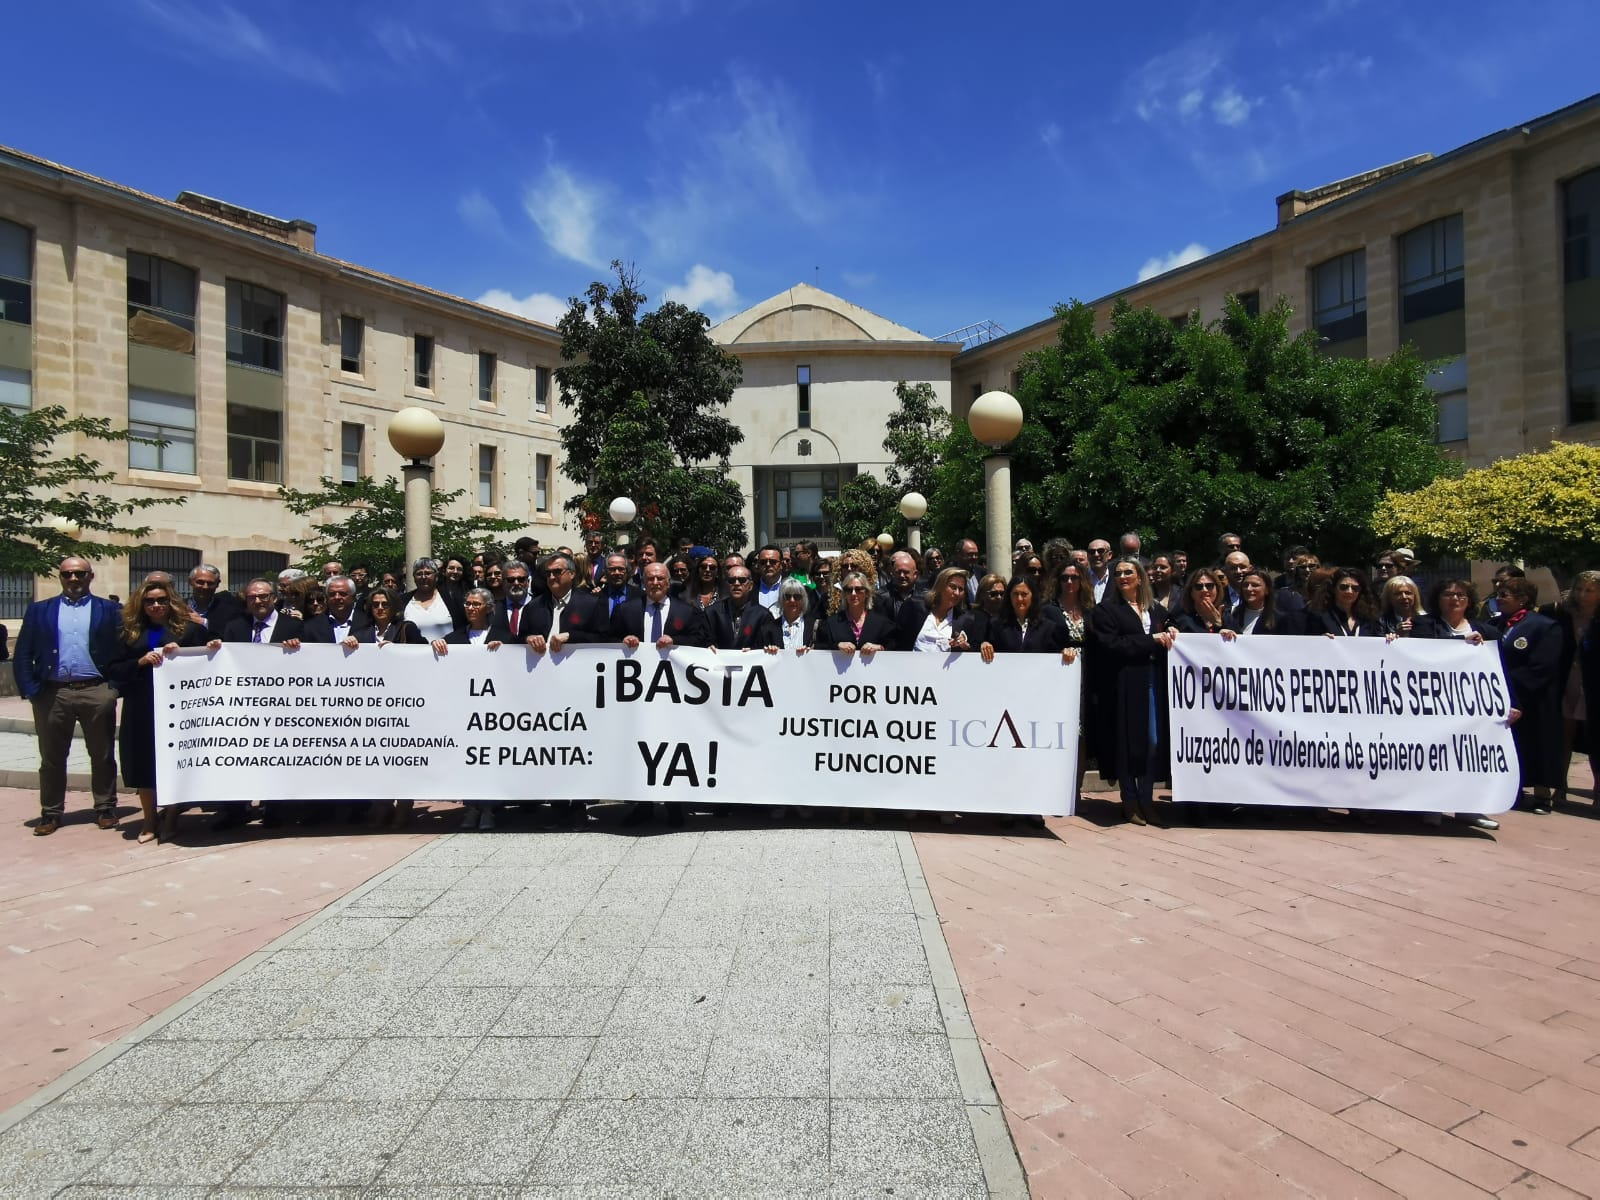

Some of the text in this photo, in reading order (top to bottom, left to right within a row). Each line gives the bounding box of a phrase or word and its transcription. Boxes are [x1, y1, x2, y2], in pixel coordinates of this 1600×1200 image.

[180, 676, 385, 690] PACTO DE ESTADO POR LA JUSTICIA
[469, 678, 496, 696] LA
[595, 659, 774, 708] ¡BASTA
[1172, 659, 1506, 717] NO PODEMOS PERDER MÁS SERVICIOS
[180, 696, 425, 710] DEFENSA INTEGRAL DEL TURNO DE OFICIO
[829, 684, 937, 705] POR UNA
[179, 714, 410, 730] CONCILIACIÓN Y DESCONEXIÓN DIGITAL
[466, 707, 587, 731] ABOGACÍA
[779, 717, 937, 742] JUSTICIA QUE
[178, 734, 458, 750] PROXIMIDAD DE LA DEFENSA A LA CIUDADANÍA.
[1176, 726, 1509, 779] Juzgado de violencia de género en Villena
[176, 753, 428, 770] NO A LA COMARCALIZACIÓN DE LA VIOGEN
[465, 746, 593, 765] SE PLANTA:
[637, 740, 718, 788] YA!
[814, 752, 936, 775] FUNCIONE
